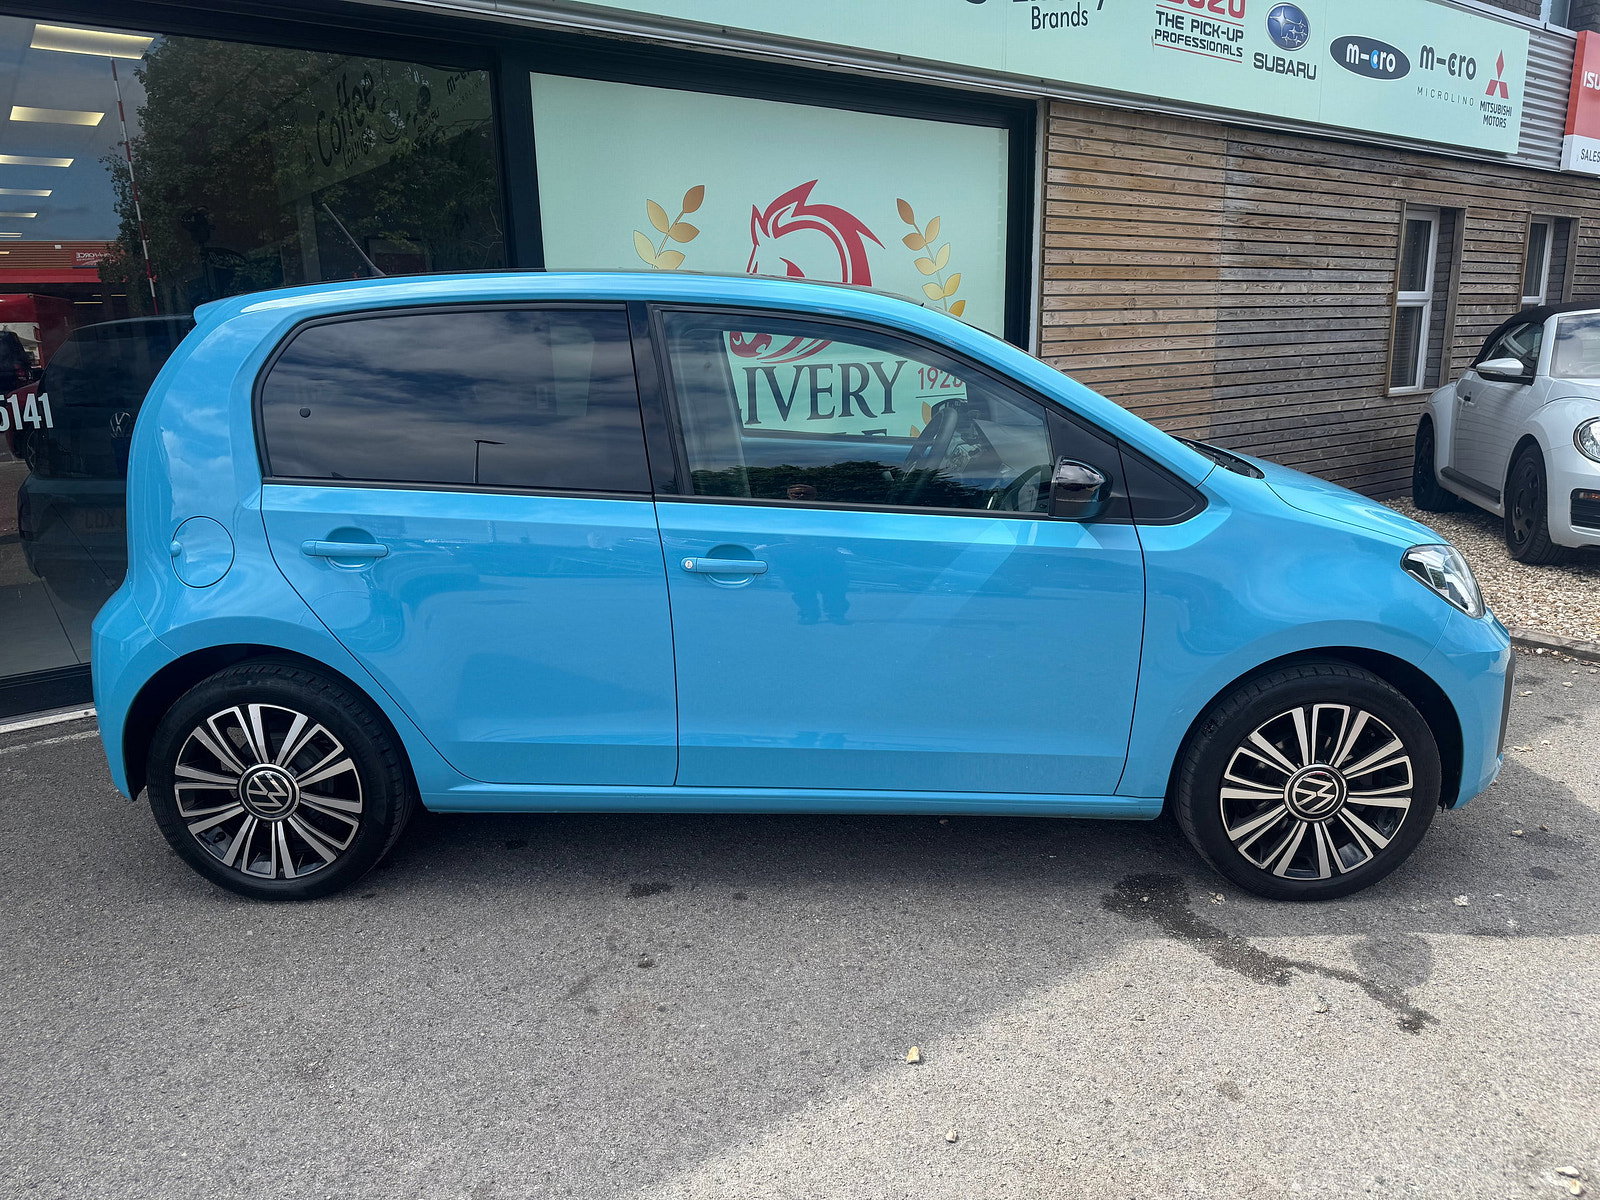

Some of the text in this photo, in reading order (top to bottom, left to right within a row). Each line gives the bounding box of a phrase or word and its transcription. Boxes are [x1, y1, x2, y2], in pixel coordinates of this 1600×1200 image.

[1031, 2, 1089, 30] Brands
[1155, 10, 1244, 43] THE PICK-UP
[1154, 28, 1243, 58] PROFESSIONALS
[1253, 52, 1317, 81] SUBARU
[1416, 86, 1475, 107] MICROLINO
[1479, 100, 1513, 117] MITSUBISHI
[1482, 114, 1507, 129] MOTORS
